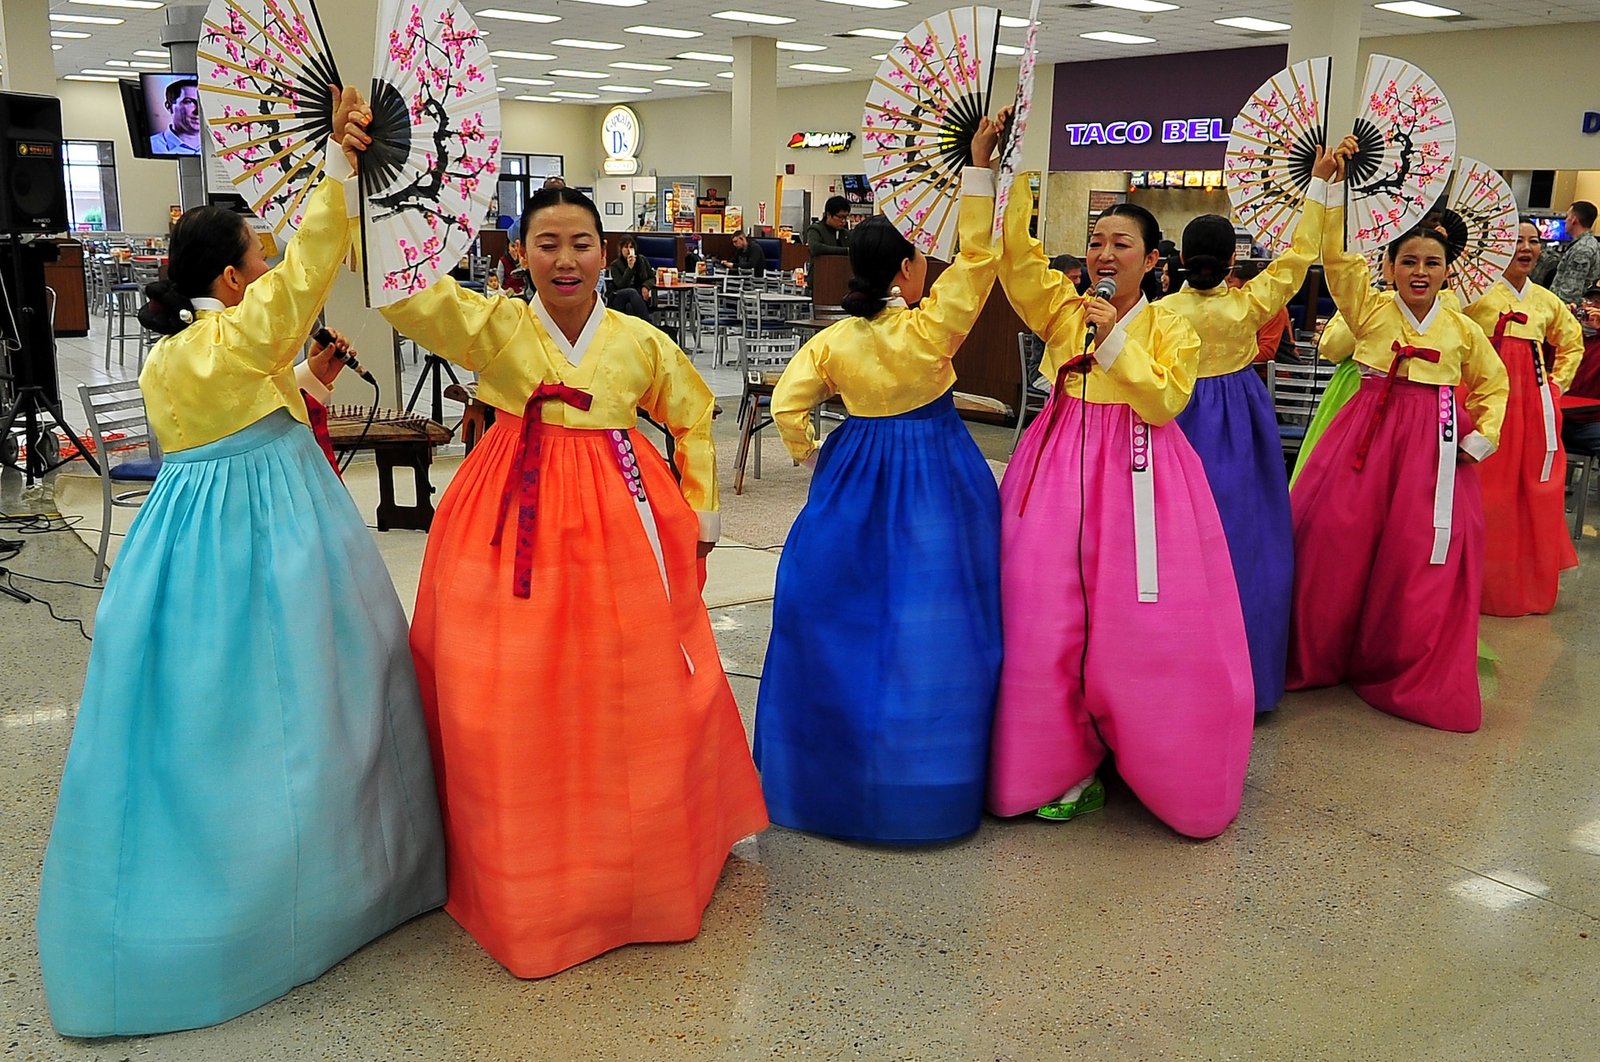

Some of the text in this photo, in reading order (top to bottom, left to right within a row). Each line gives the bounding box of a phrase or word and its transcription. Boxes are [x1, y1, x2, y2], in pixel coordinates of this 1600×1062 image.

[605, 113, 632, 133] Captain
[1065, 118, 1235, 145] TACO BEL
[613, 130, 629, 154] D's
